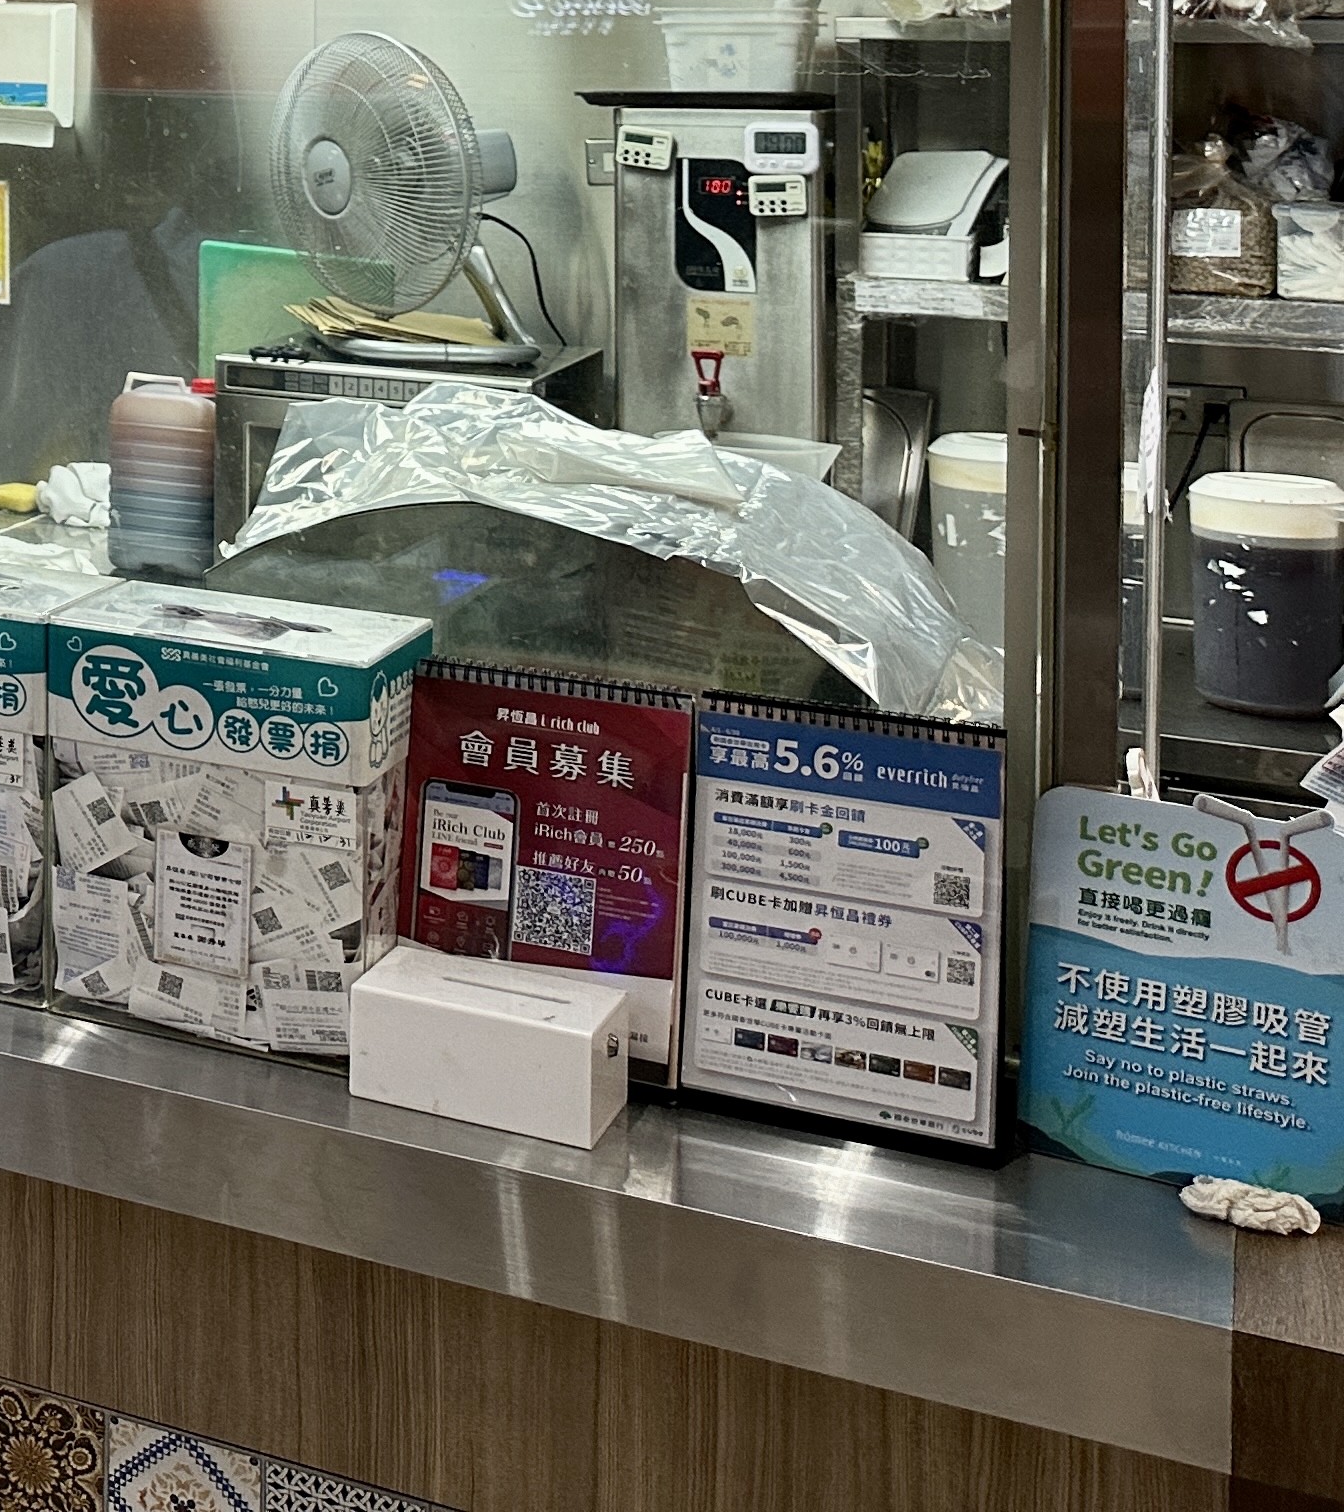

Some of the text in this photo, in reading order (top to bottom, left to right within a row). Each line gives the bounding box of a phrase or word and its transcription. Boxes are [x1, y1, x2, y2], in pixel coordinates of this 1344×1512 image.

[576, 717, 601, 736] club
[459, 729, 635, 790] 會員募集
[709, 745, 769, 771] 享最高
[773, 738, 864, 780] 5.6%
[876, 765, 948, 789] everrich
[432, 817, 506, 841] iRich Club
[535, 801, 600, 826] 首次註冊
[534, 821, 657, 857] iRich會員 250
[1078, 815, 1218, 862] Let's Go
[532, 849, 597, 876] 推薦好友
[617, 864, 643, 883] 50
[1077, 848, 1214, 898] Green!
[1057, 961, 1332, 1047] 不使用塑膠吸管
[1053, 999, 1329, 1087] 減塑生活一起來
[1063, 1064, 1313, 1133] Join the plastic-free lifestyle.
[1085, 1049, 1297, 1108] Say no to plastic straws.
